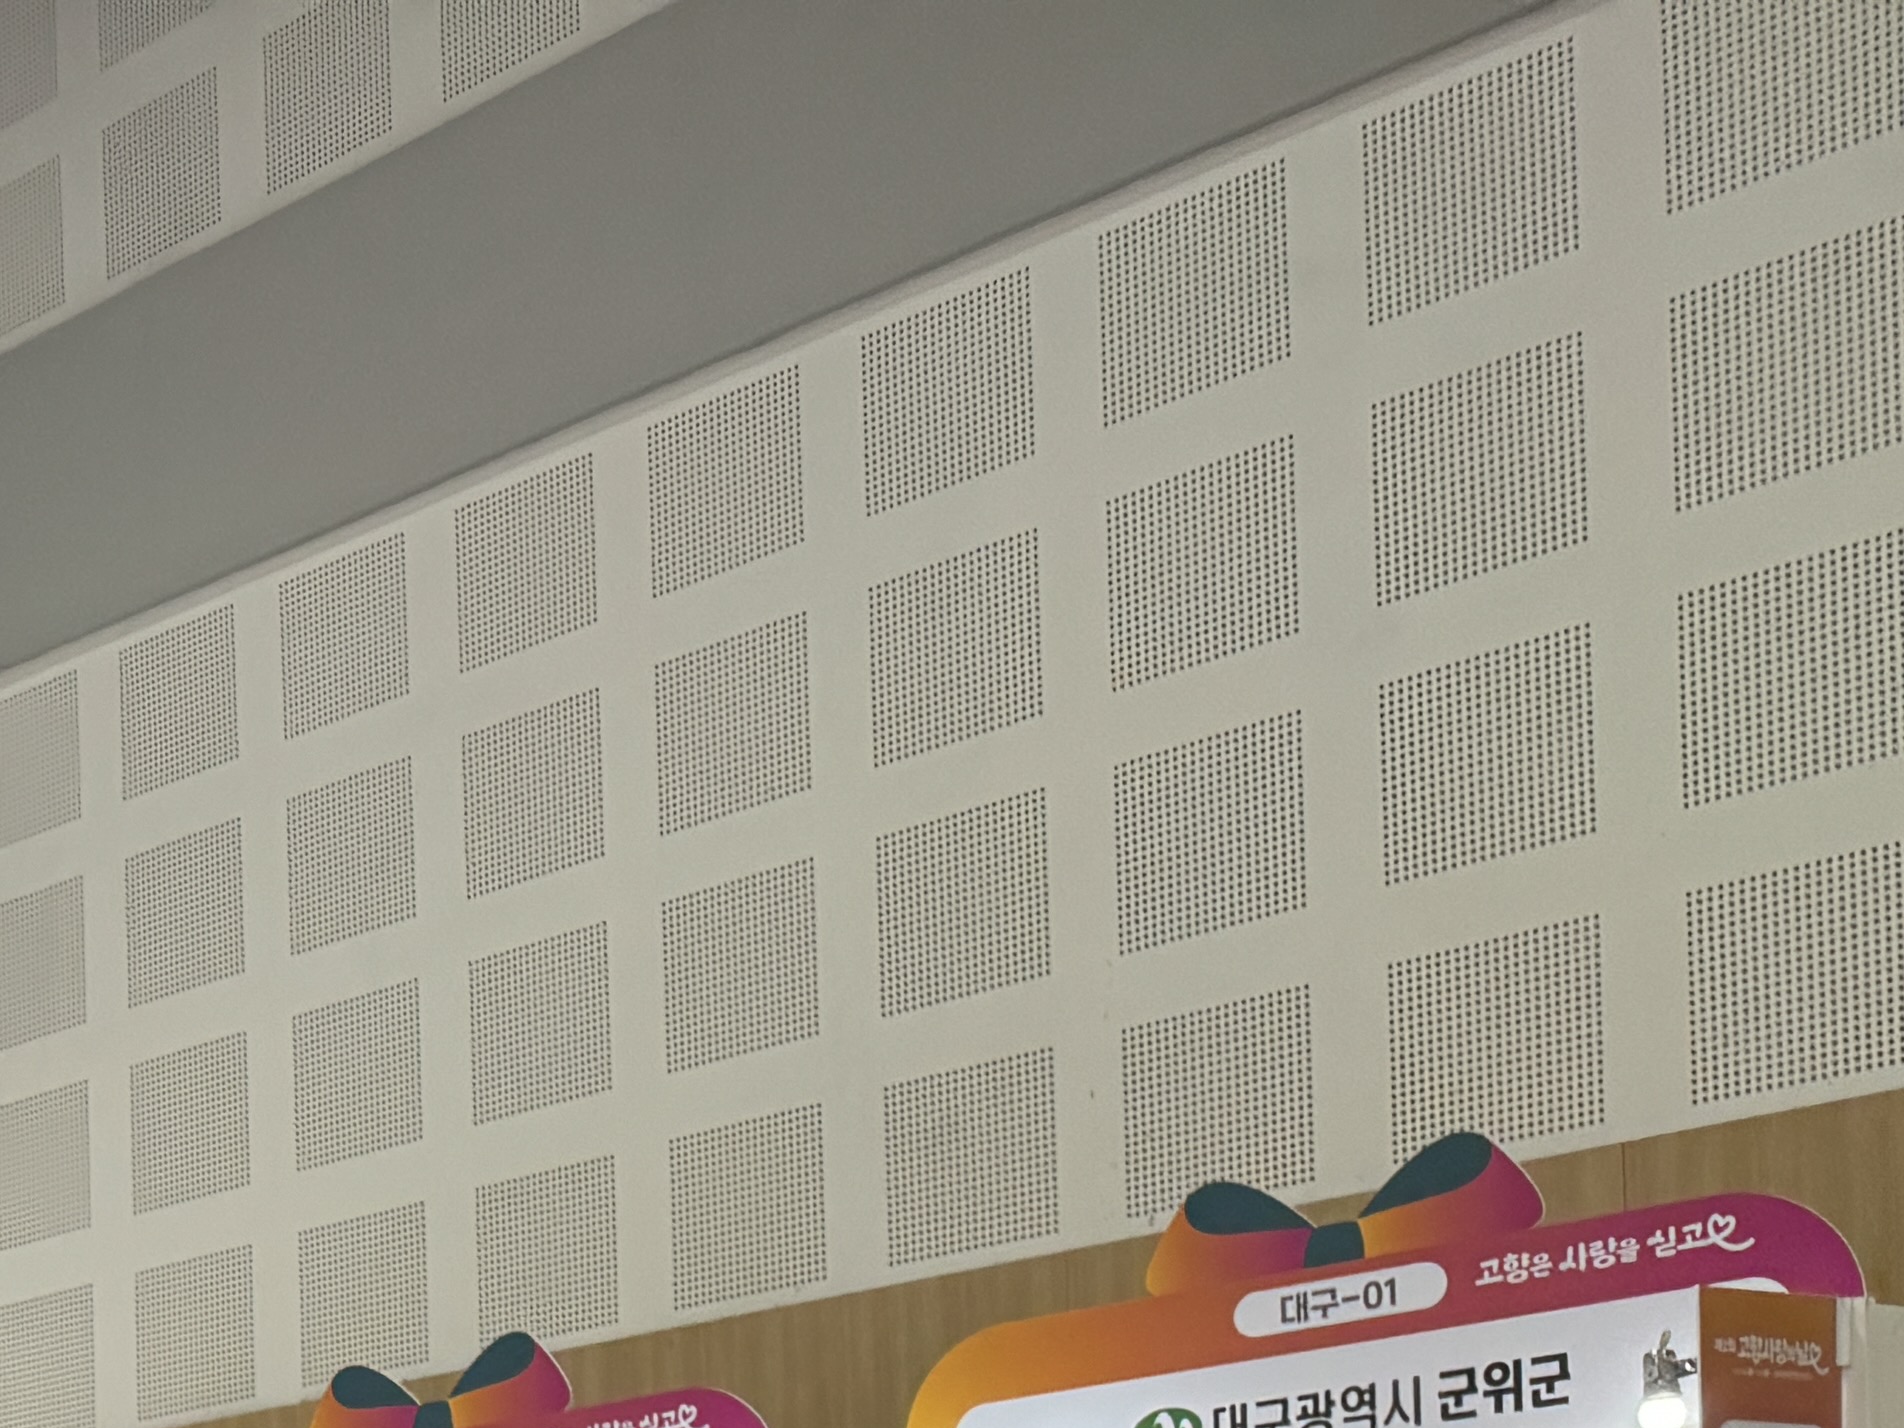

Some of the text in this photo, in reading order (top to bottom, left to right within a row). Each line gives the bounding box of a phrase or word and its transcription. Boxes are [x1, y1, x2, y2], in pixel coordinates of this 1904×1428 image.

[1474, 1245, 1552, 1287] 고향은
[1558, 1233, 1641, 1275] 사랑을
[1279, 1278, 1399, 1326] 대구-01
[1437, 1352, 1572, 1420] 군위군
